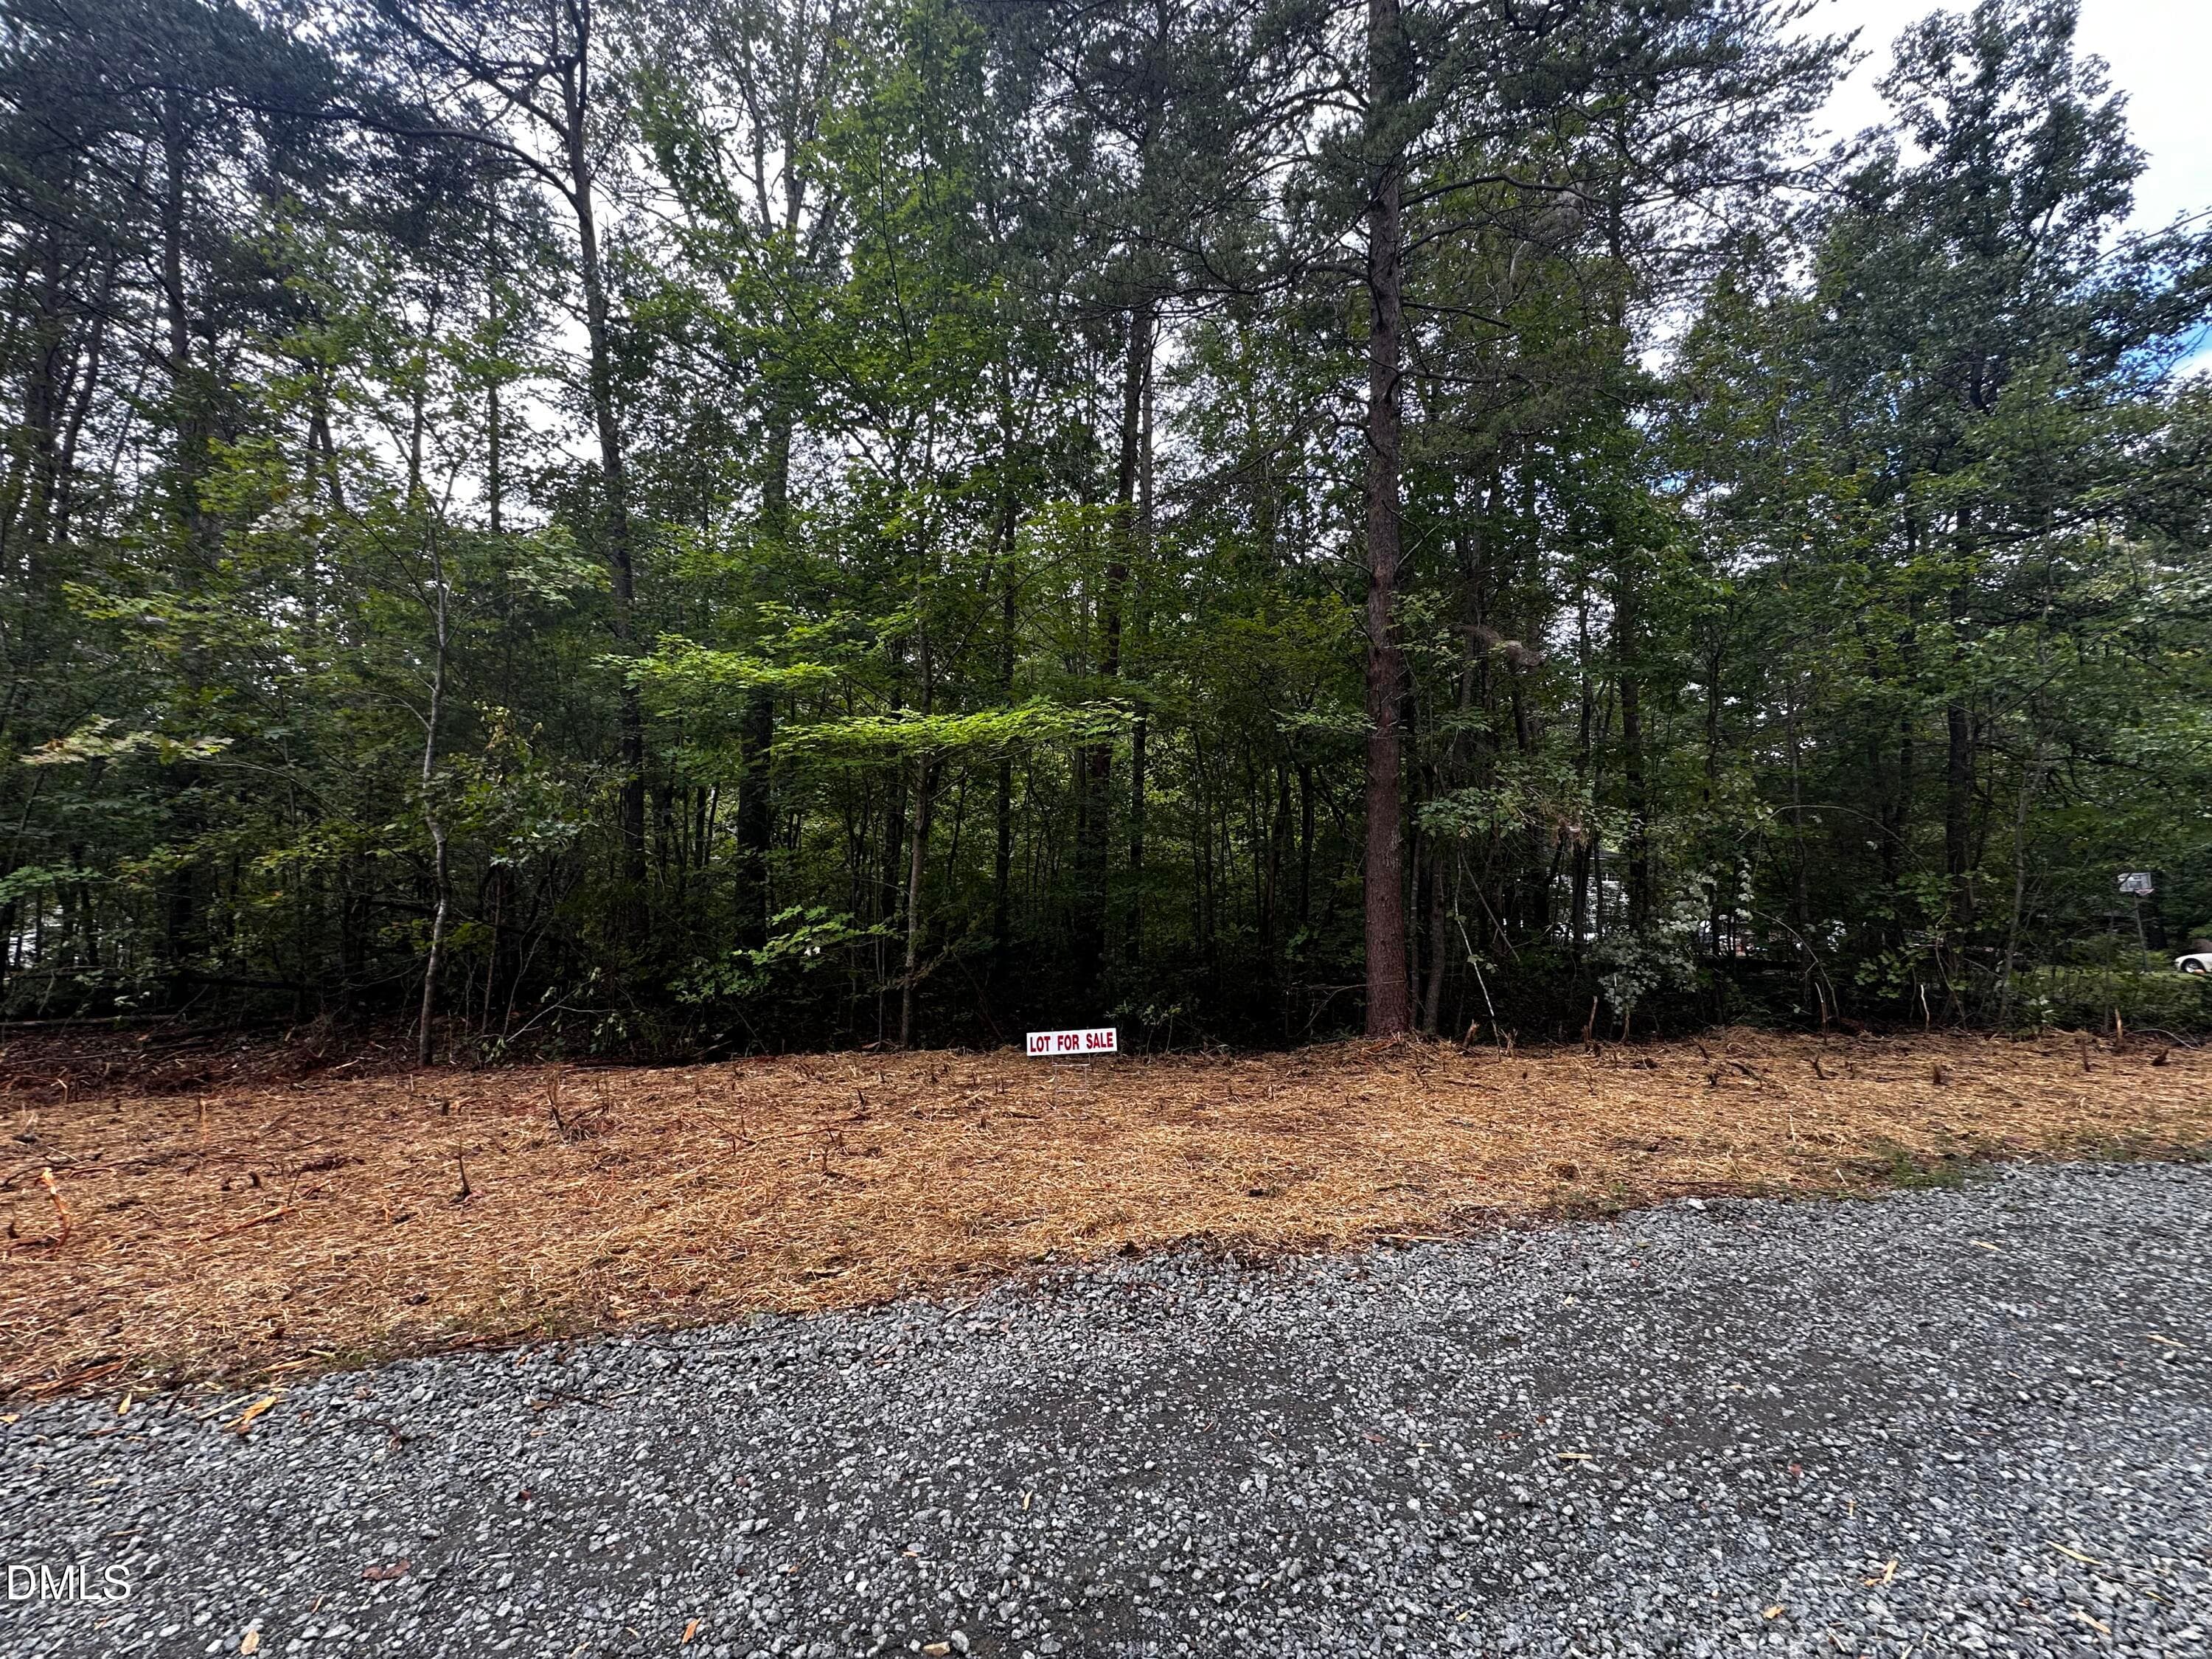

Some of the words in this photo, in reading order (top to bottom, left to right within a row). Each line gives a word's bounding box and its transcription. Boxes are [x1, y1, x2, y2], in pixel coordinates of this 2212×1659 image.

[1030, 1036, 1051, 1052] LOT
[1057, 1034, 1079, 1051] FOR
[1086, 1032, 1113, 1049] SALE
